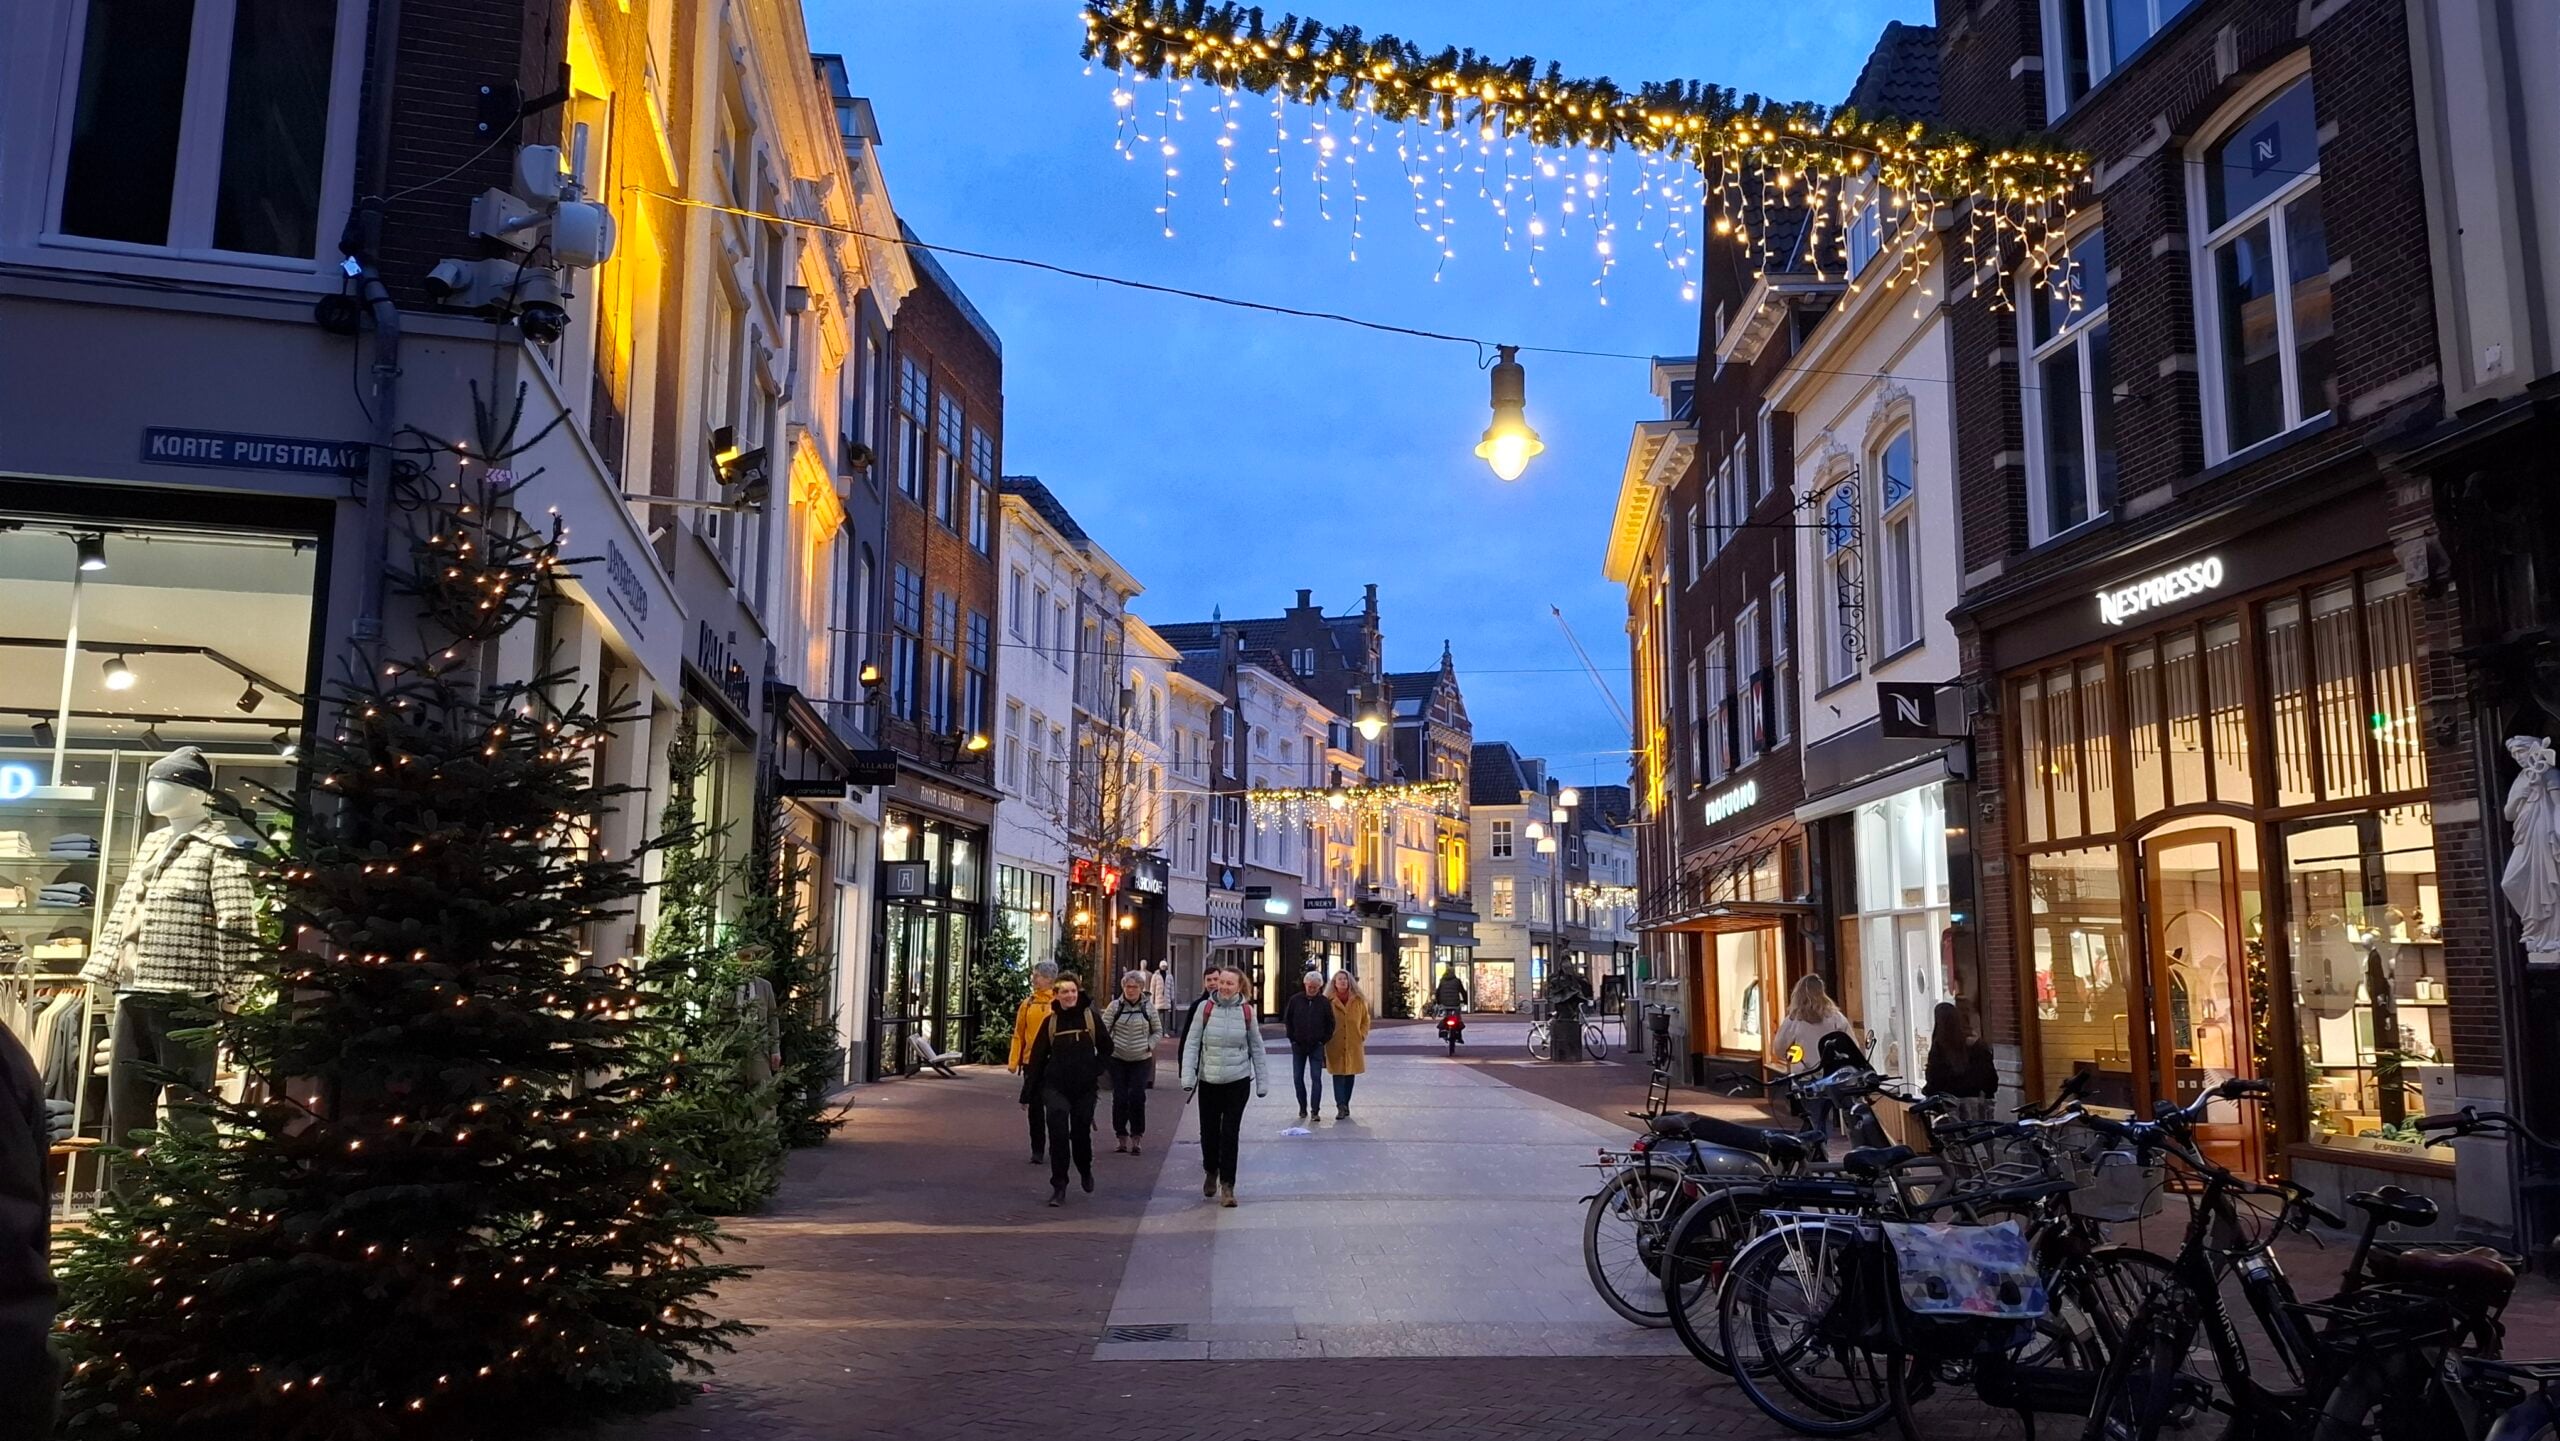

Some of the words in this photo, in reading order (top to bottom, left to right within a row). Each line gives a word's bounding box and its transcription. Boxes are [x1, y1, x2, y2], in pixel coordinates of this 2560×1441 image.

[151, 434, 224, 460] KORTE
[2095, 556, 2223, 626] NESPRESSO
[920, 785, 937, 805] ANNA
[938, 791, 950, 809] VAN
